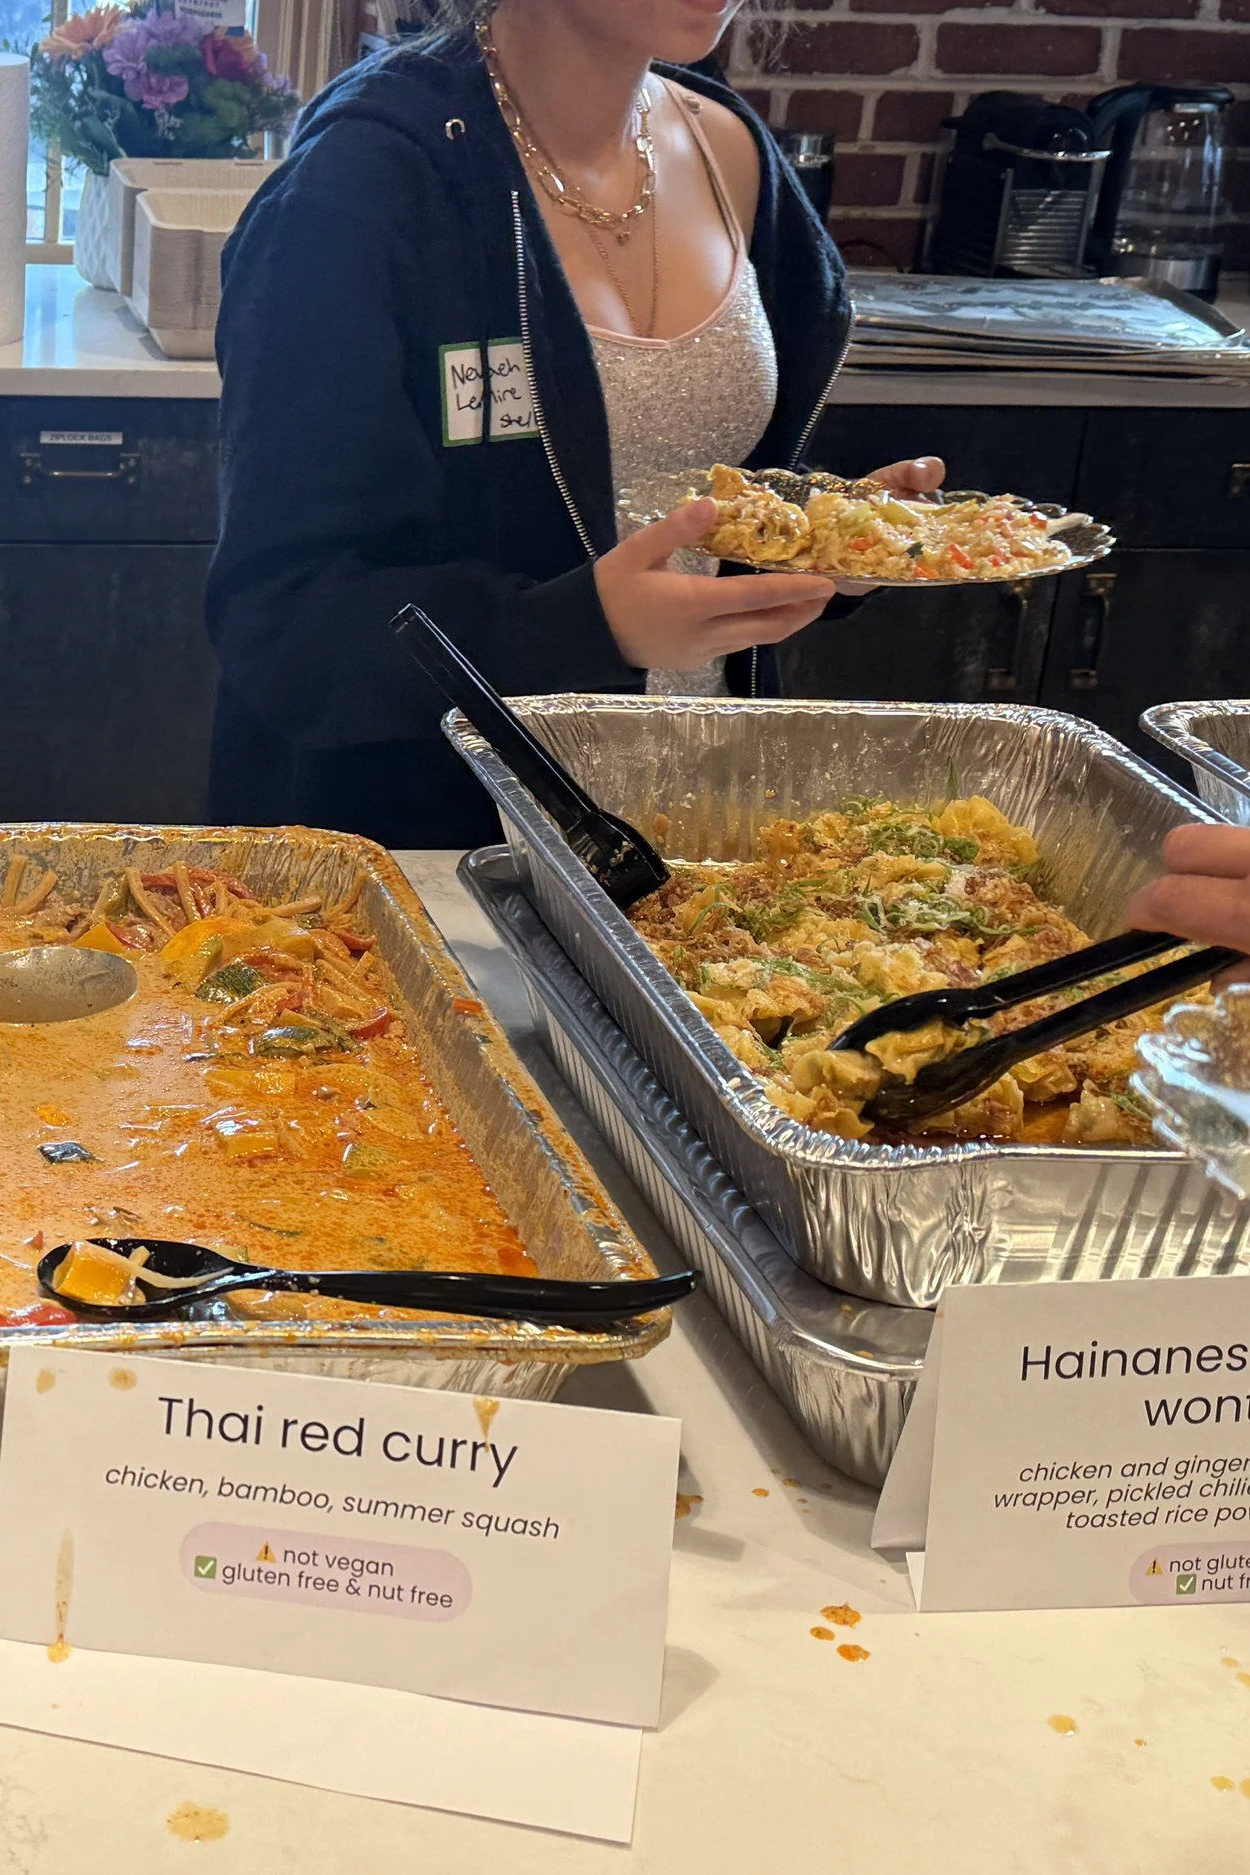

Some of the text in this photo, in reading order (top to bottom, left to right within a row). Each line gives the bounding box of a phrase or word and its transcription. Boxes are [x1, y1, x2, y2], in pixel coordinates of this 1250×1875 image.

[1021, 1339, 1249, 1382] Hainanes
[157, 1396, 519, 1489] Thai red curry
[1019, 1454, 1250, 1483] chicken and ginger
[105, 1464, 560, 1540] chicken, bamboo, summer squash
[994, 1477, 1250, 1512] wrapper, pickled chili
[1065, 1504, 1250, 1529] toasted rice po
[283, 1549, 394, 1579] not vegan
[1169, 1556, 1202, 1573] not
[221, 1562, 453, 1609] gluten free & nut free
[1201, 1574, 1234, 1591] nut
